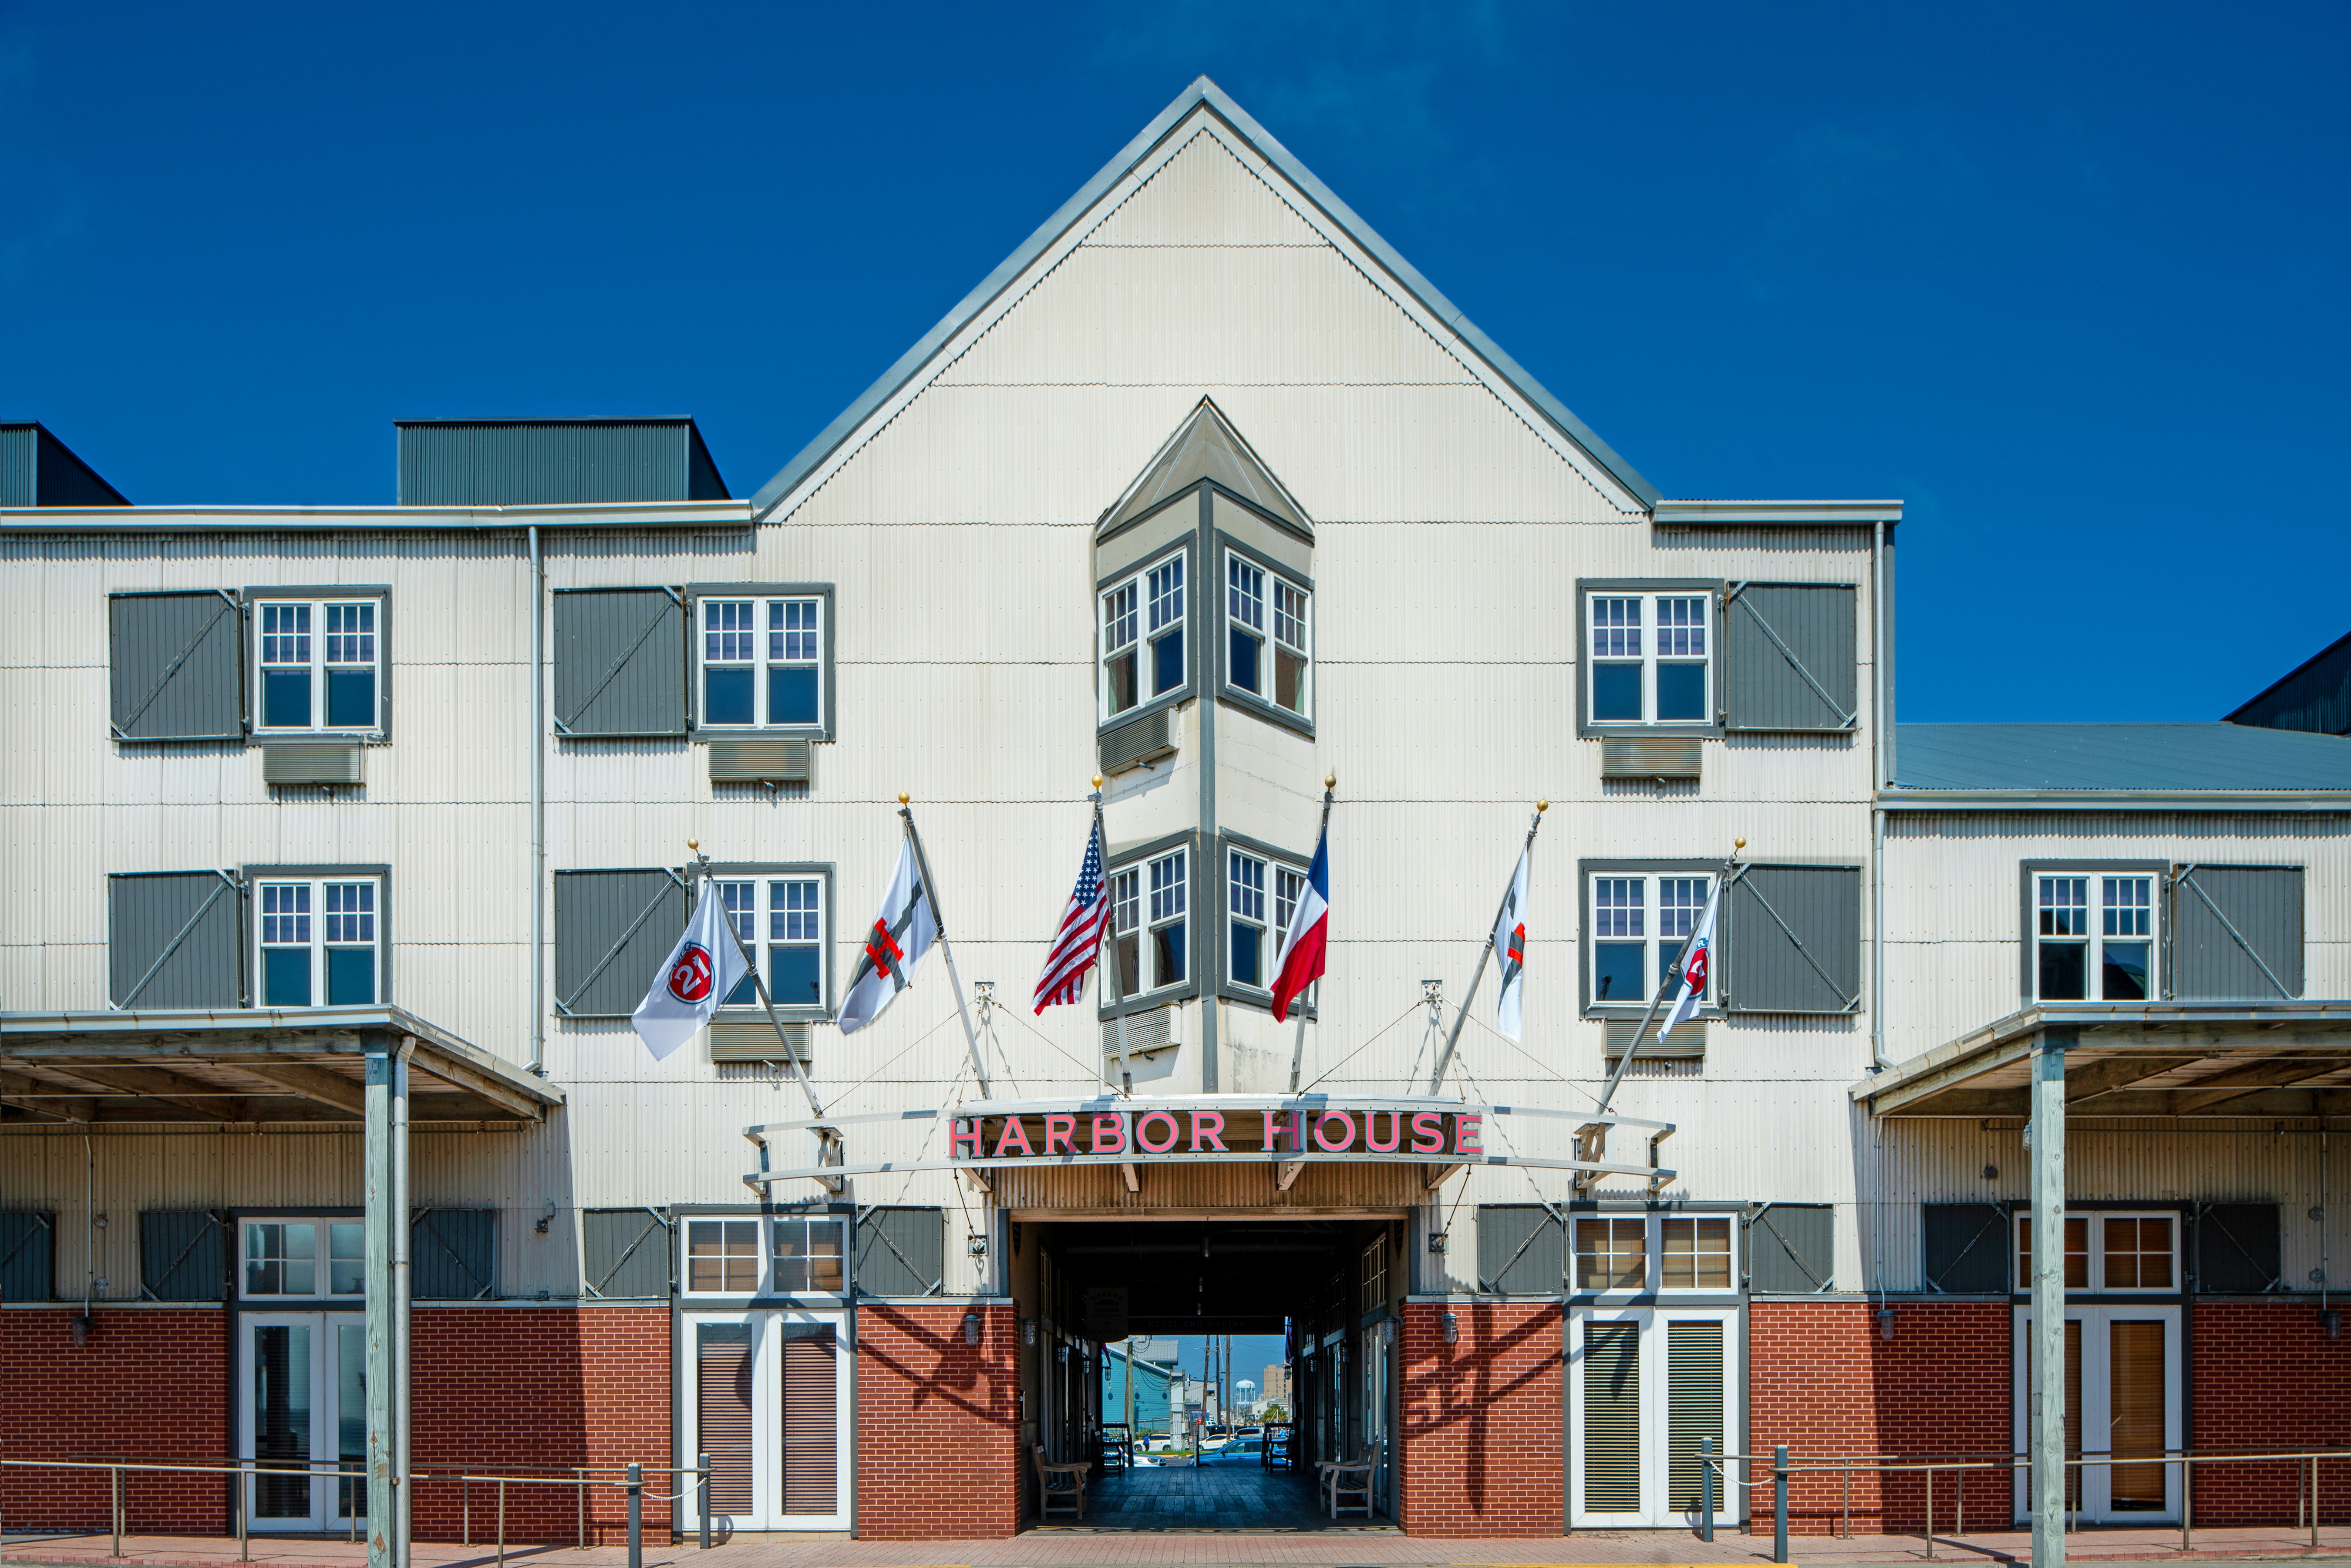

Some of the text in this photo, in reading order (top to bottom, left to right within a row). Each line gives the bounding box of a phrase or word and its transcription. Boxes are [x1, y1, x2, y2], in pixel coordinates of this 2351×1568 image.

[674, 954, 711, 995] 21
[946, 1110, 1484, 1158] HARBOR HOUSE
